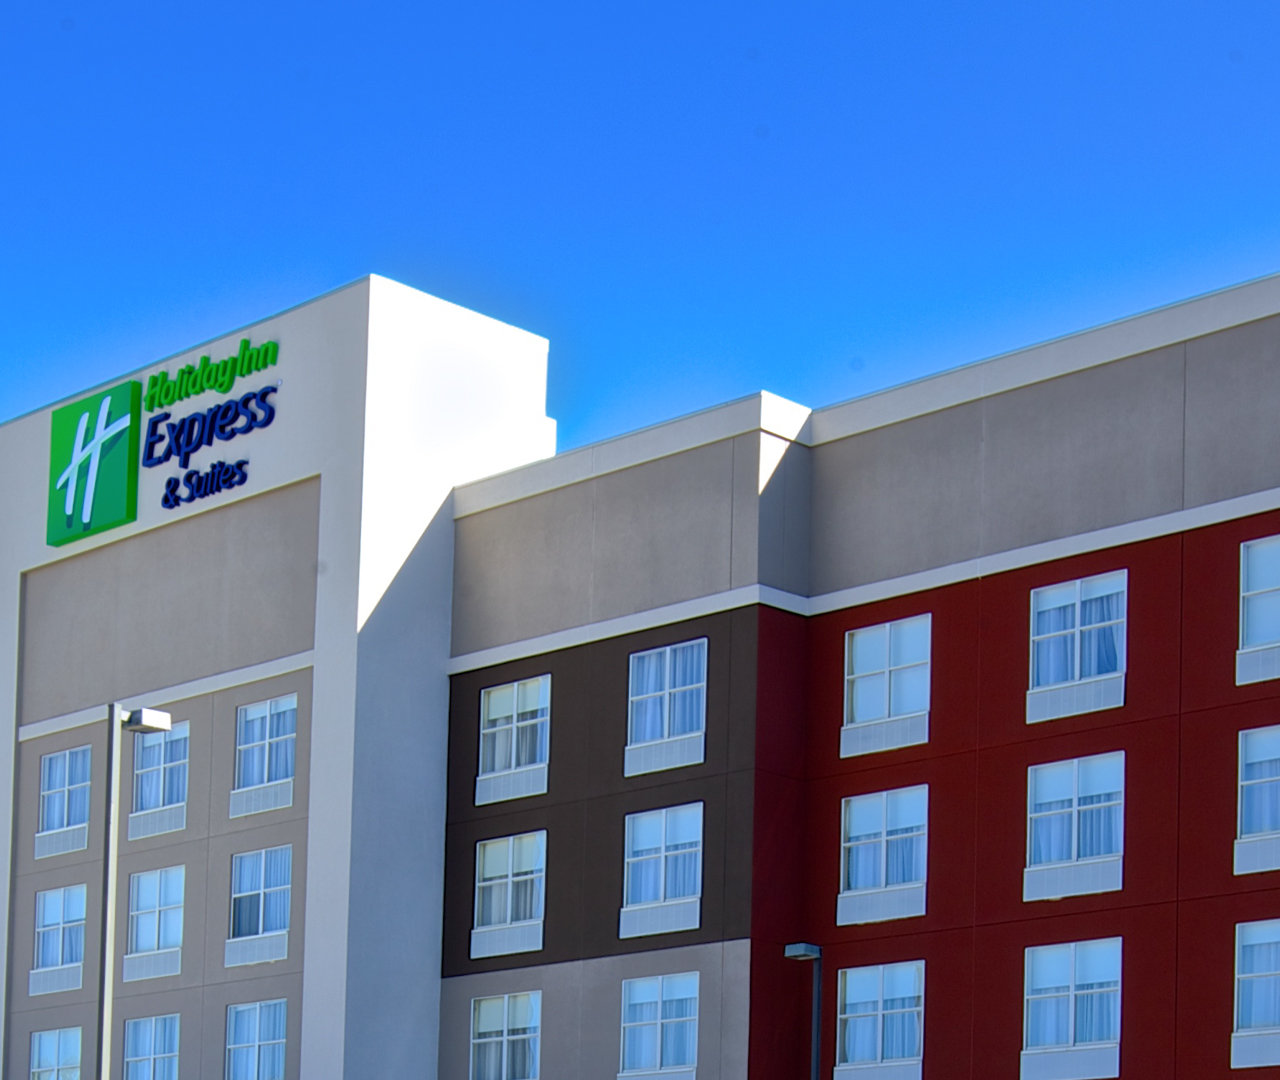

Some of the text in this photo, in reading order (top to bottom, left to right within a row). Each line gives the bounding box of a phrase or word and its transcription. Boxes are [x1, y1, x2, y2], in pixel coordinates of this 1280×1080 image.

[142, 386, 278, 469] Express
[161, 459, 249, 509] & Suites
